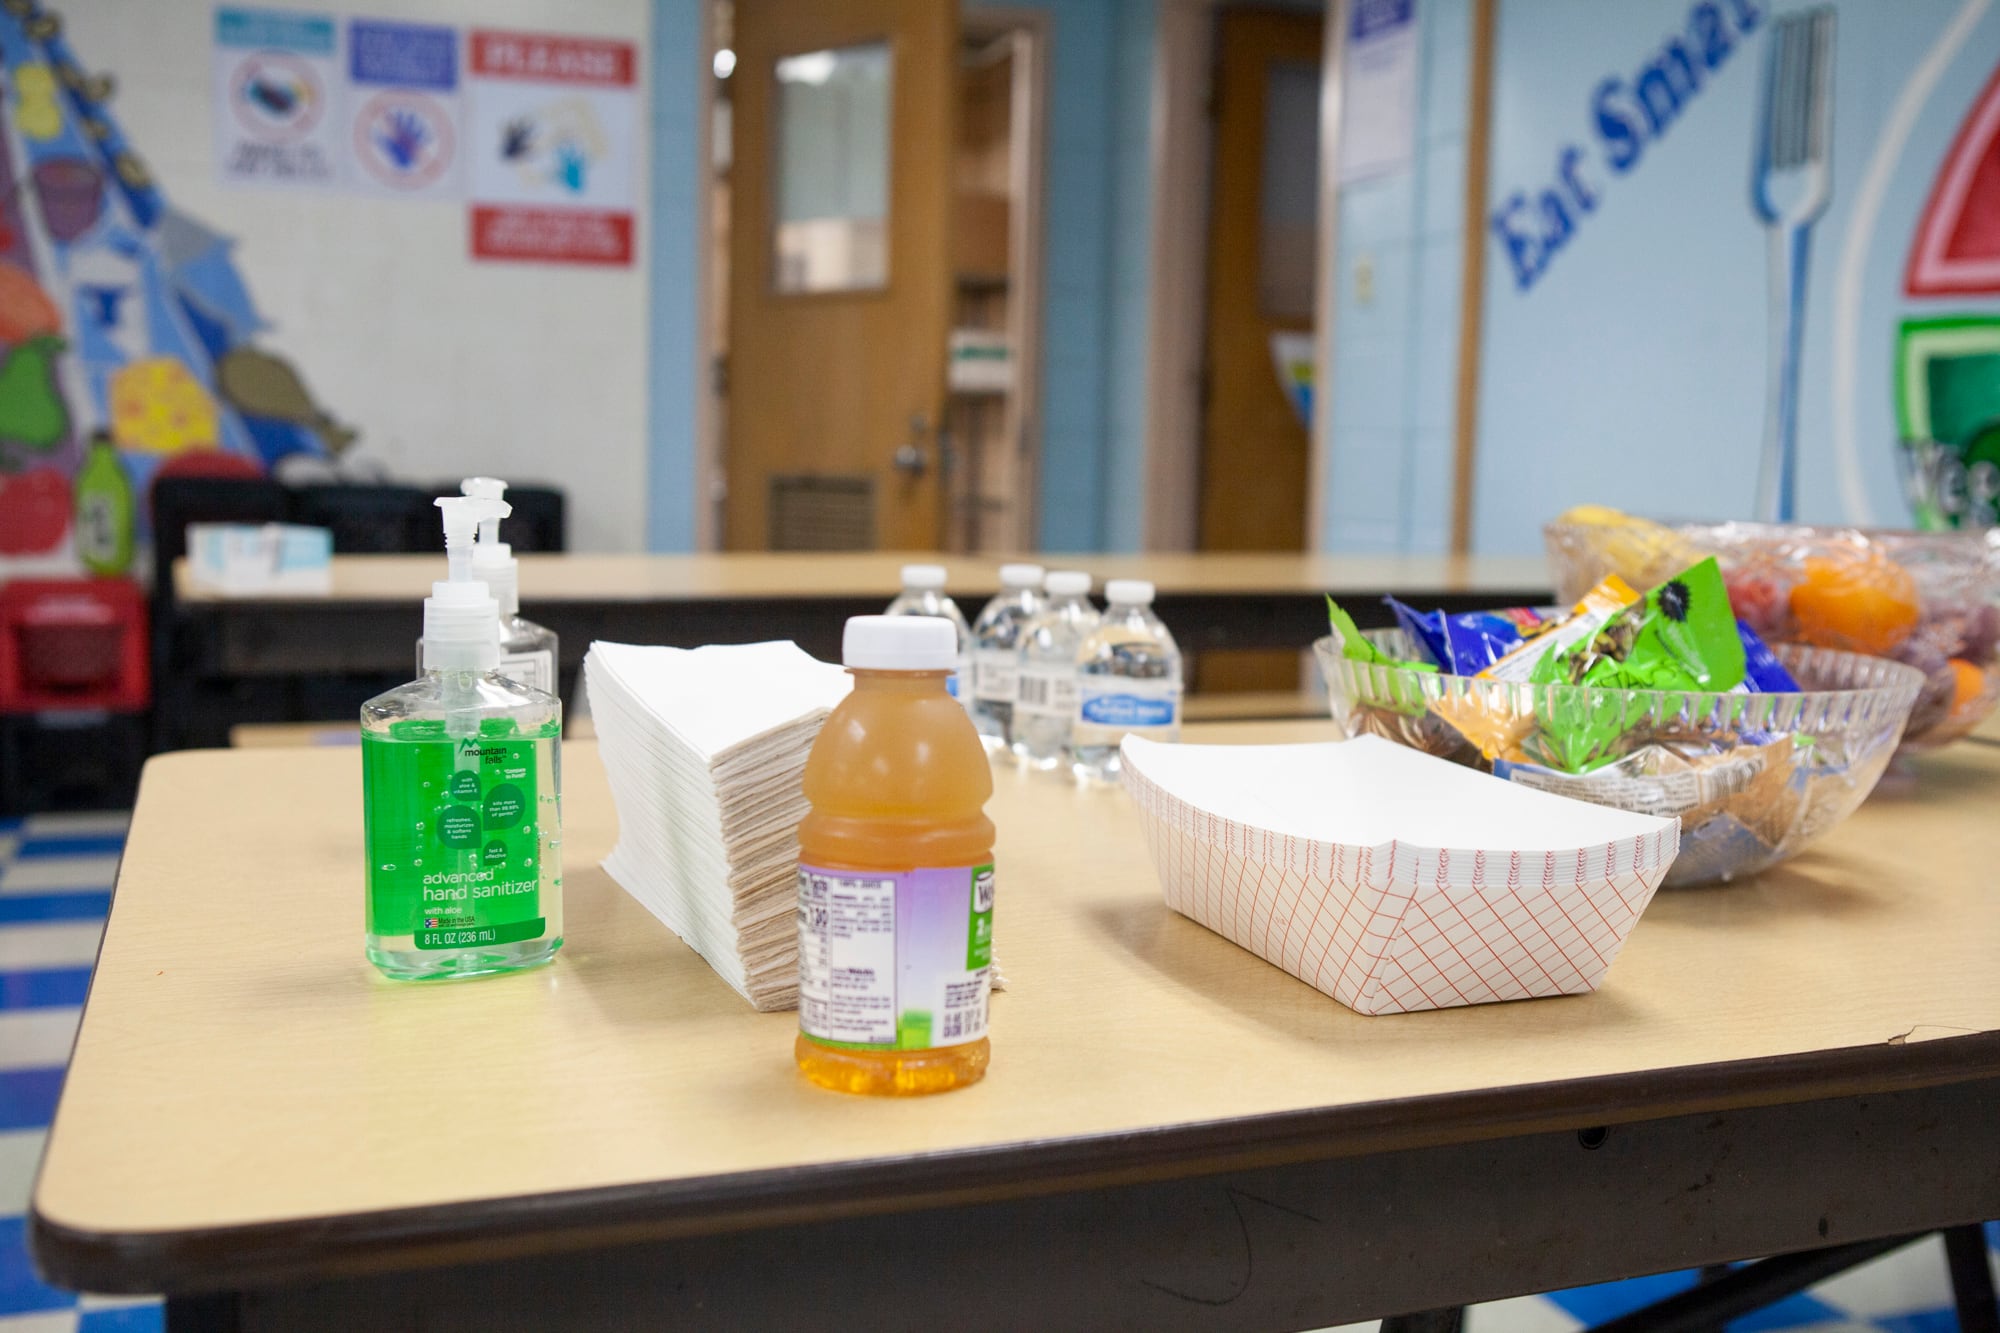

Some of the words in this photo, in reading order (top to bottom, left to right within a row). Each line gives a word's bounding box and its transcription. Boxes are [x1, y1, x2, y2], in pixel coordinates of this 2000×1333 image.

[484, 37, 617, 75] PLEASE
[1491, 145, 1602, 292] Eat
[464, 747, 507, 757] mountain
[423, 868, 494, 884] advanced
[423, 884, 467, 901] hand
[473, 880, 538, 898] sanitizer
[424, 907, 443, 915] with
[444, 906, 462, 914] aloe
[424, 934, 430, 944] 8
[432, 934, 442, 944] FL
[444, 932, 456, 944] OZ
[458, 931, 477, 944] (236
[479, 928, 496, 942] mL)
